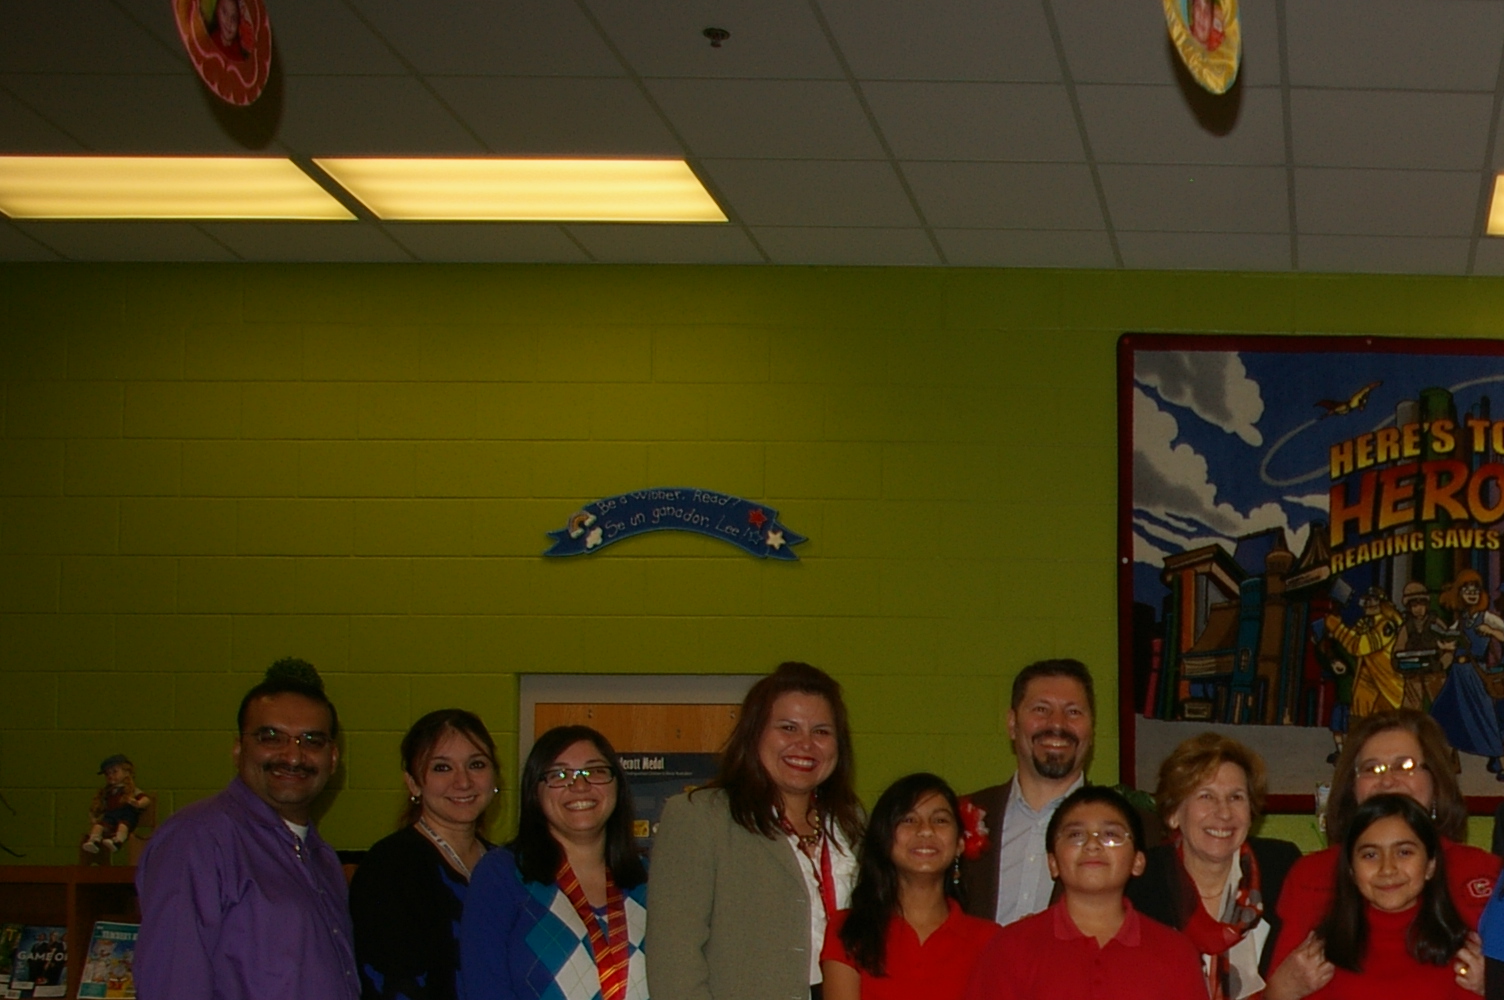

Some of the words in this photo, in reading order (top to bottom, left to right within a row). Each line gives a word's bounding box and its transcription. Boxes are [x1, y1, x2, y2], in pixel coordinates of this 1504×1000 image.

[1330, 419, 1455, 480] HERE'S
[596, 500, 617, 516] Be
[604, 520, 626, 538] Se
[630, 512, 646, 526] un
[1330, 531, 1425, 575] READING
[1431, 526, 1500, 550] SAVES
[16, 950, 51, 961] GAME
